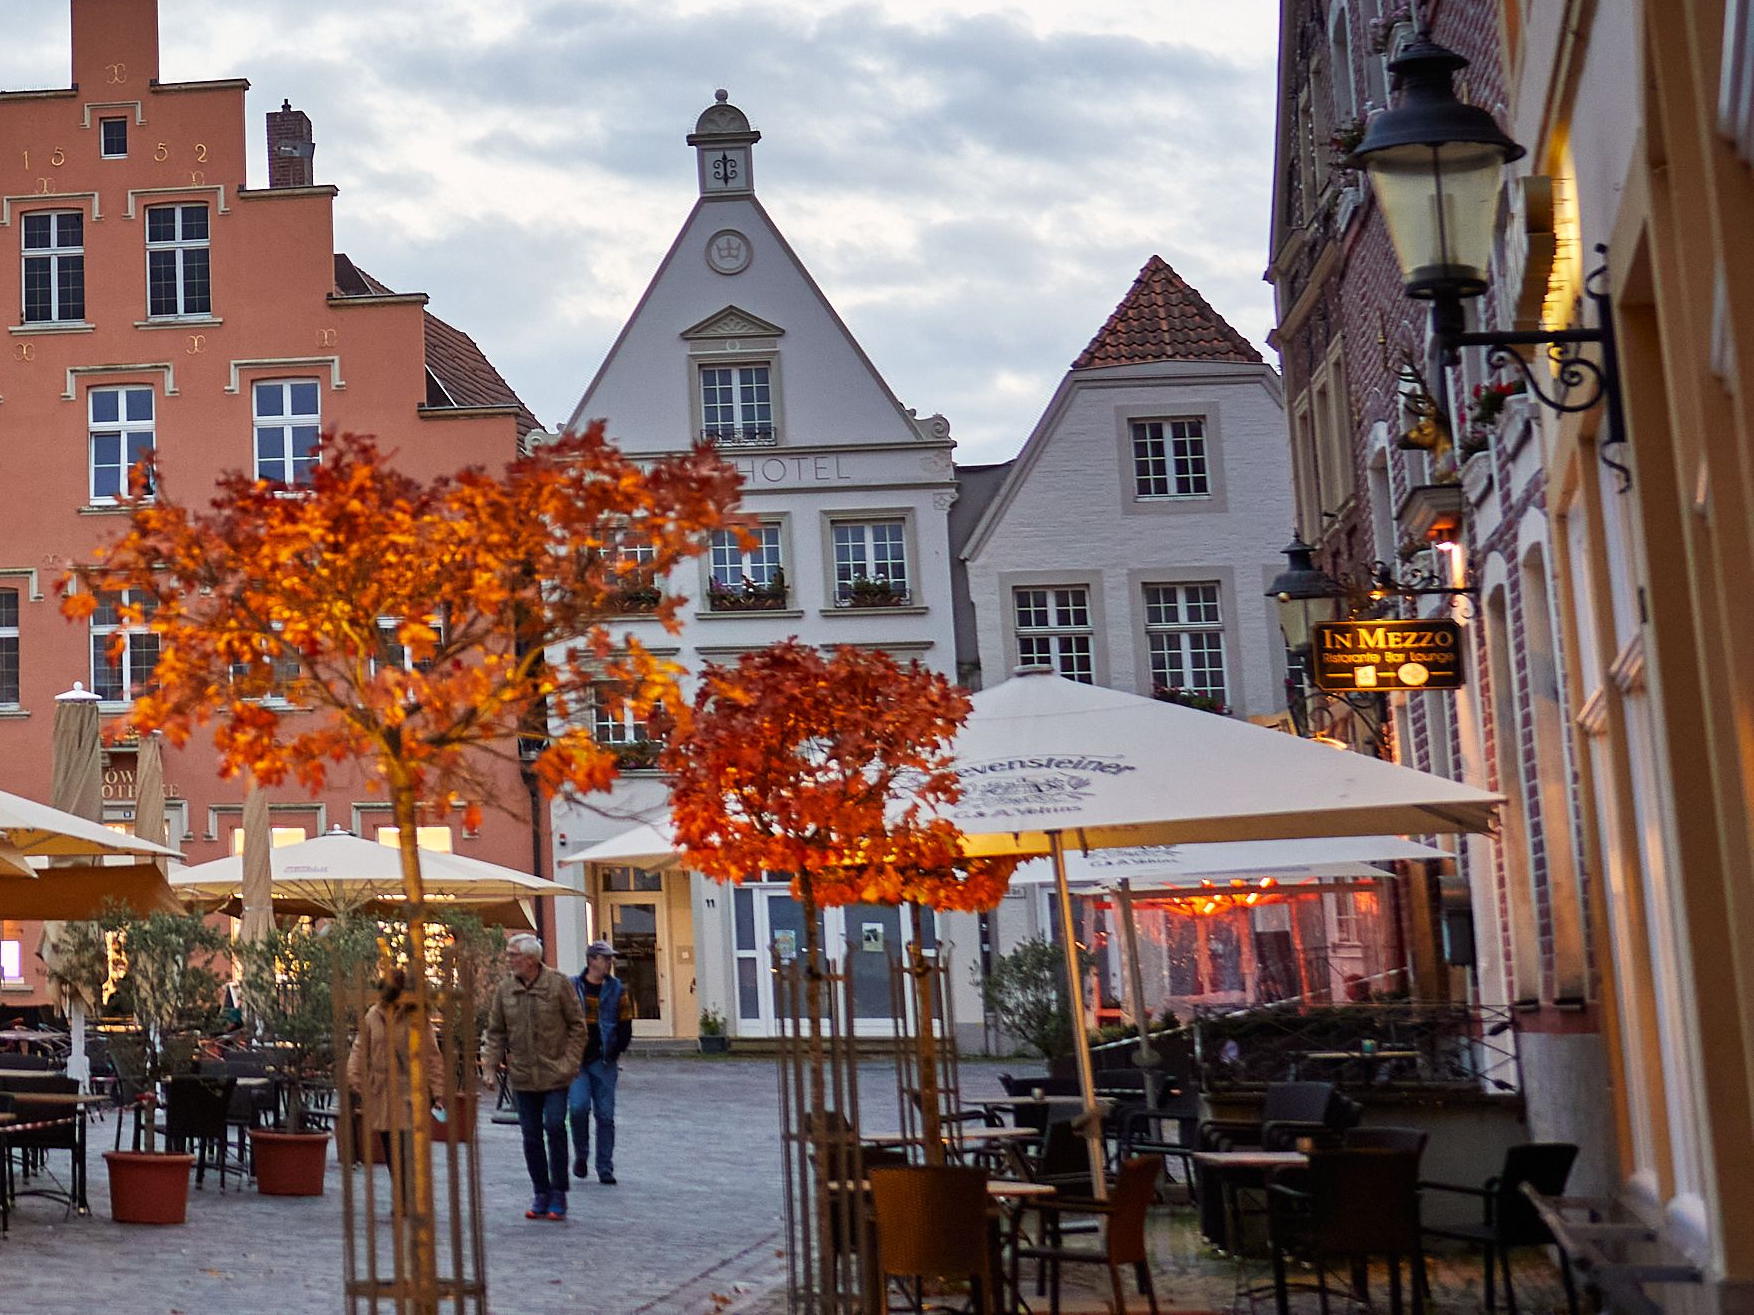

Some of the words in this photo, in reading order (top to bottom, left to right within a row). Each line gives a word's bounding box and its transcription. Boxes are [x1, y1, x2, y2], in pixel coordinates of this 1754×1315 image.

[1323, 651, 1381, 664] Ristorante
[1384, 651, 1406, 663] Bar
[1409, 651, 1454, 663] Lounge
[955, 755, 1136, 778] evensteiner
[705, 898, 716, 909] 11
